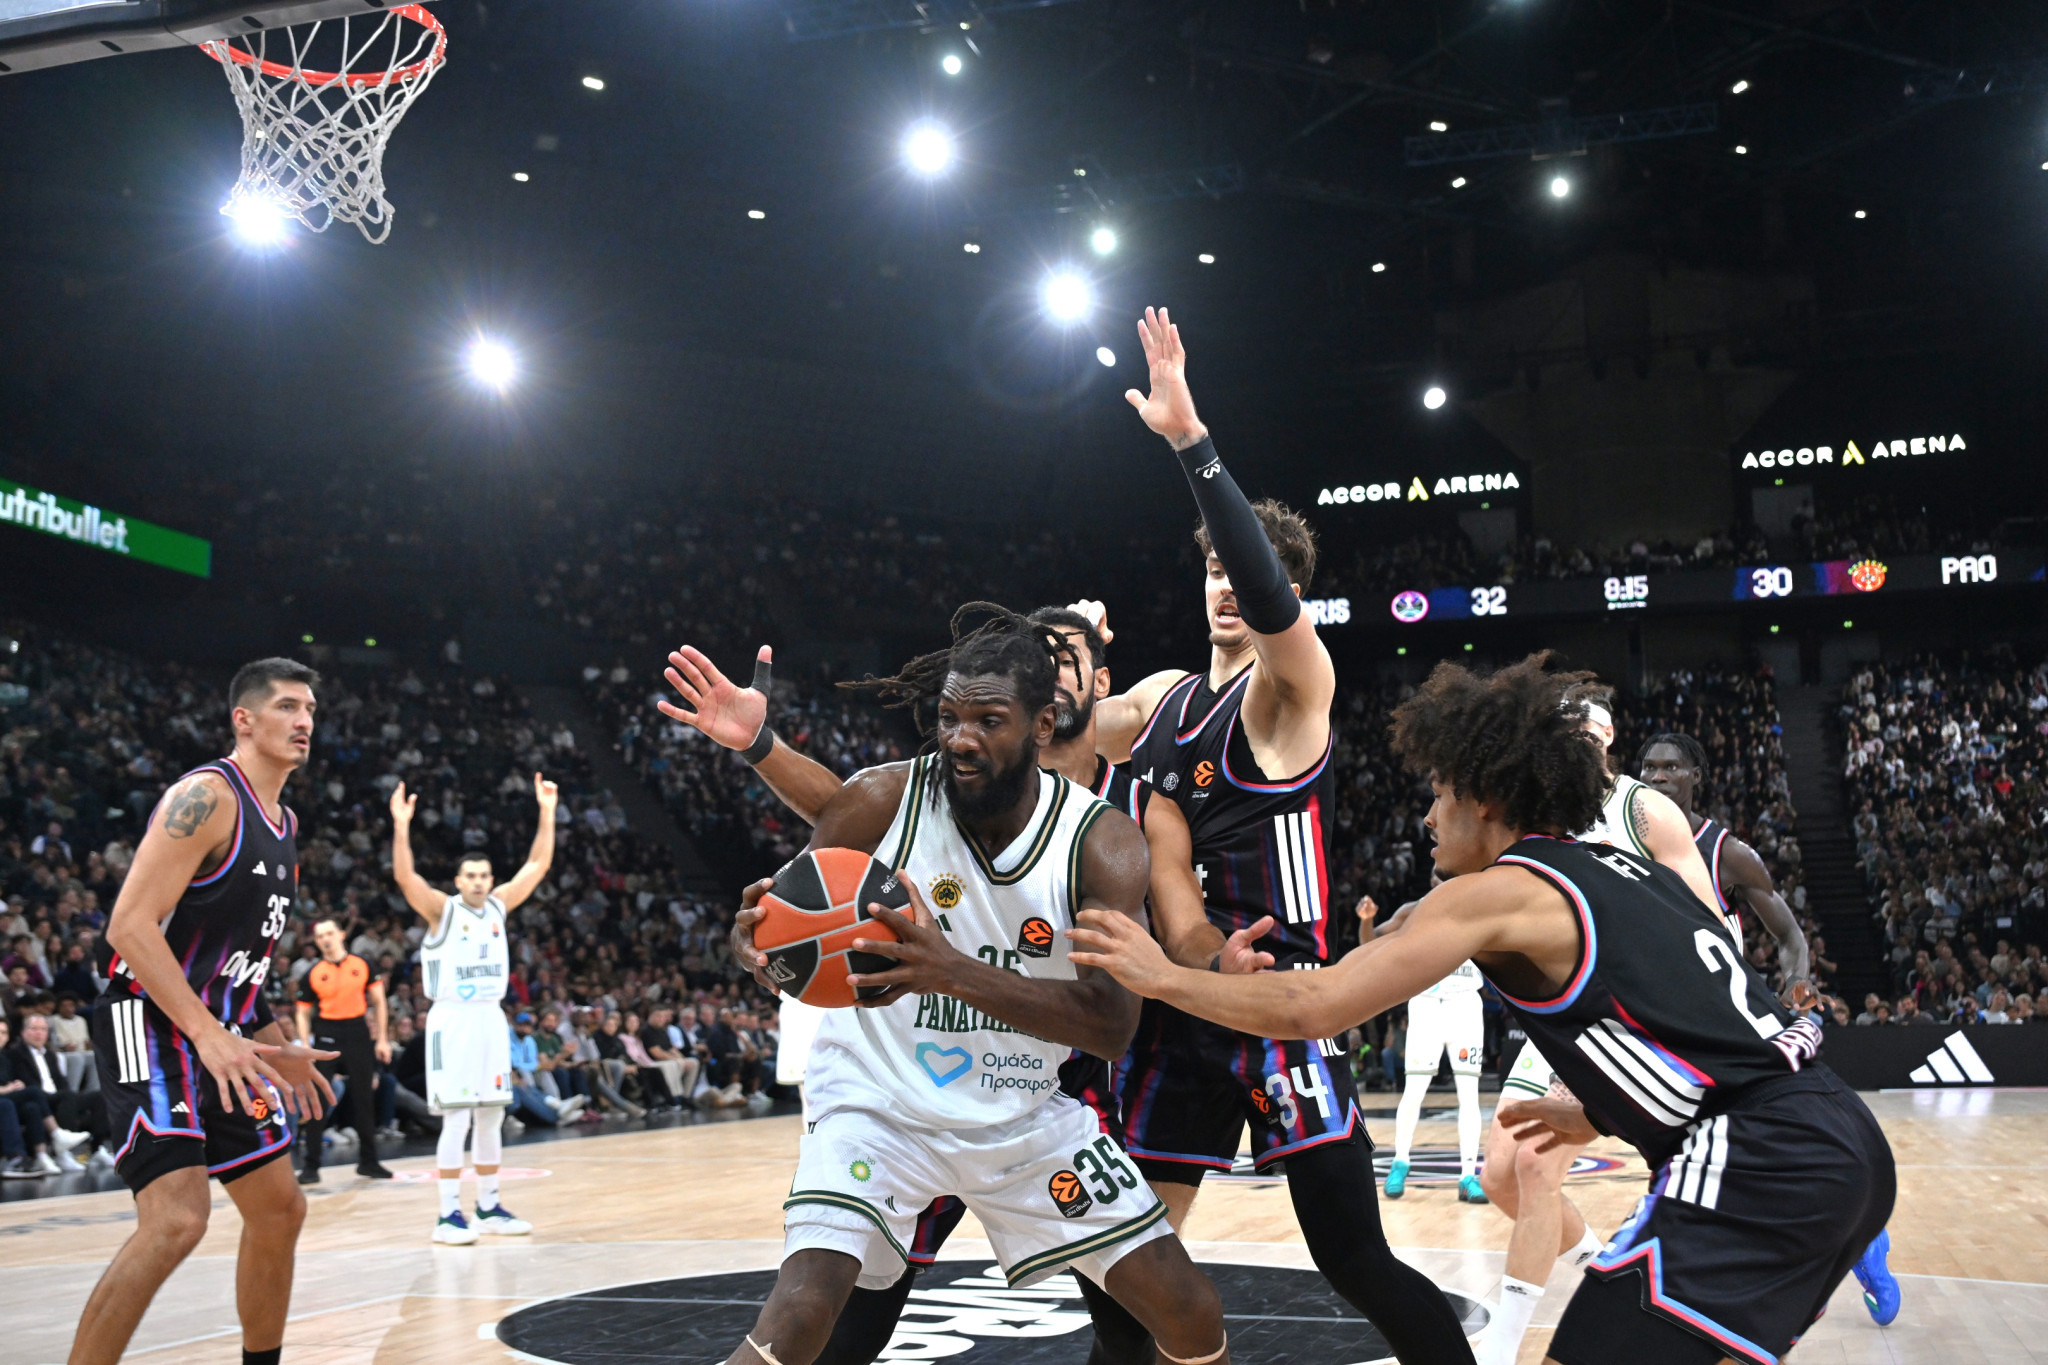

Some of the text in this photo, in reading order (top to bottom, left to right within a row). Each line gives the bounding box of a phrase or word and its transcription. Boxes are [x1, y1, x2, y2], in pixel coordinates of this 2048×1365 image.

[1741, 433, 1967, 470] ACCOR ARENA
[1317, 472, 1520, 506] ACCOR ARENA
[1751, 566, 1793, 598] 30
[1940, 554, 1998, 585] PAO
[1470, 585, 1508, 617] 32
[260, 893, 291, 941] 35
[1693, 928, 1785, 1041] 2
[982, 1052, 1043, 1072] Ομάδα
[1264, 1062, 1332, 1130] 34
[1072, 1134, 1138, 1205] 35
